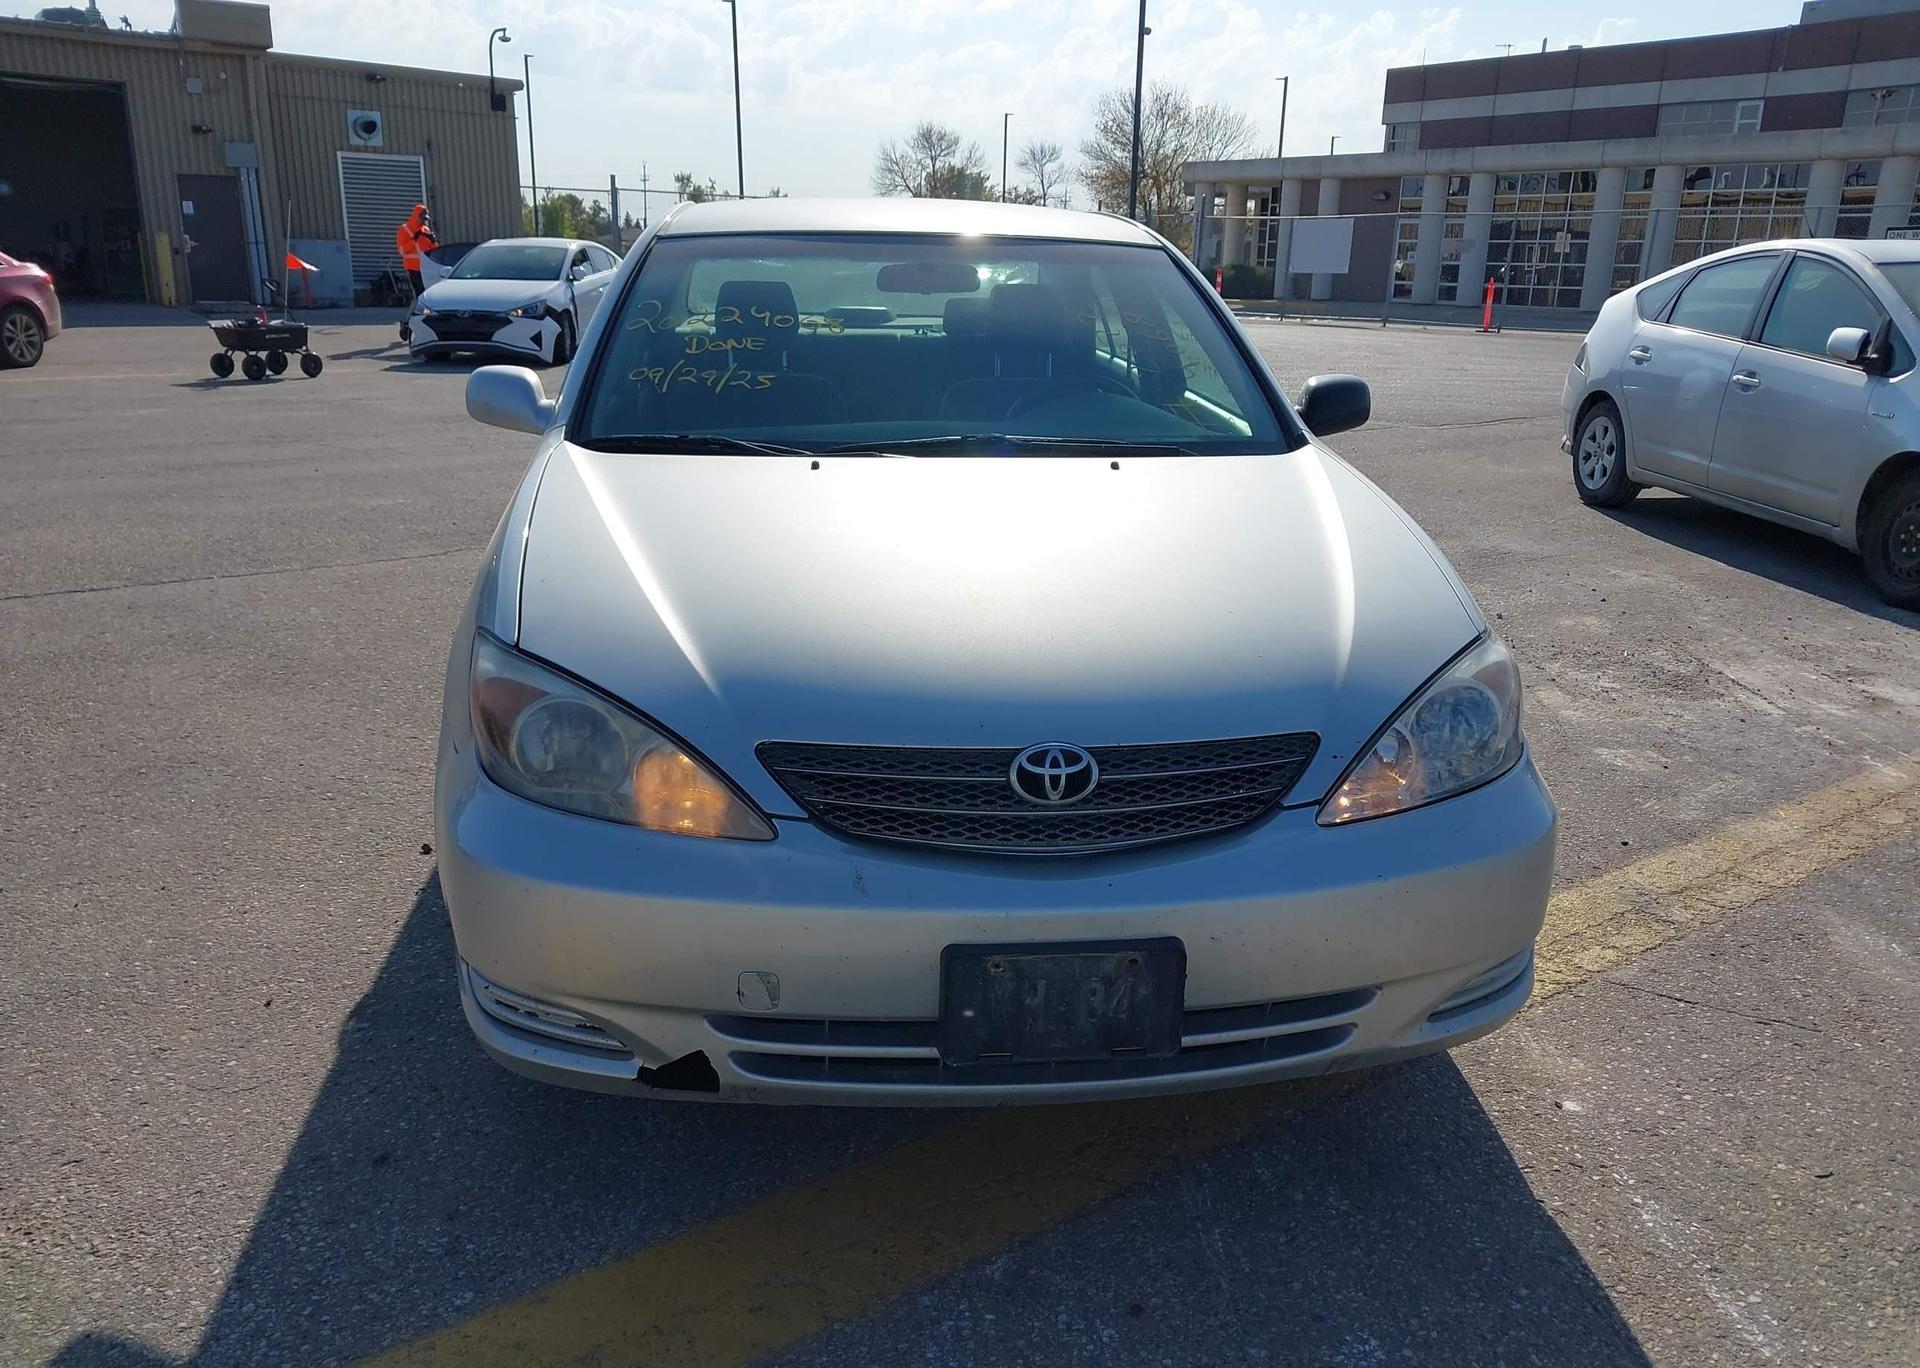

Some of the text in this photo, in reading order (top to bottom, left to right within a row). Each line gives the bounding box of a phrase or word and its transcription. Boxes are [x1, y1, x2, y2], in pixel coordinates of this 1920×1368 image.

[1889, 231, 1908, 239] ONE
[686, 335, 766, 354] DONE
[628, 360, 776, 394] 09/29/25
